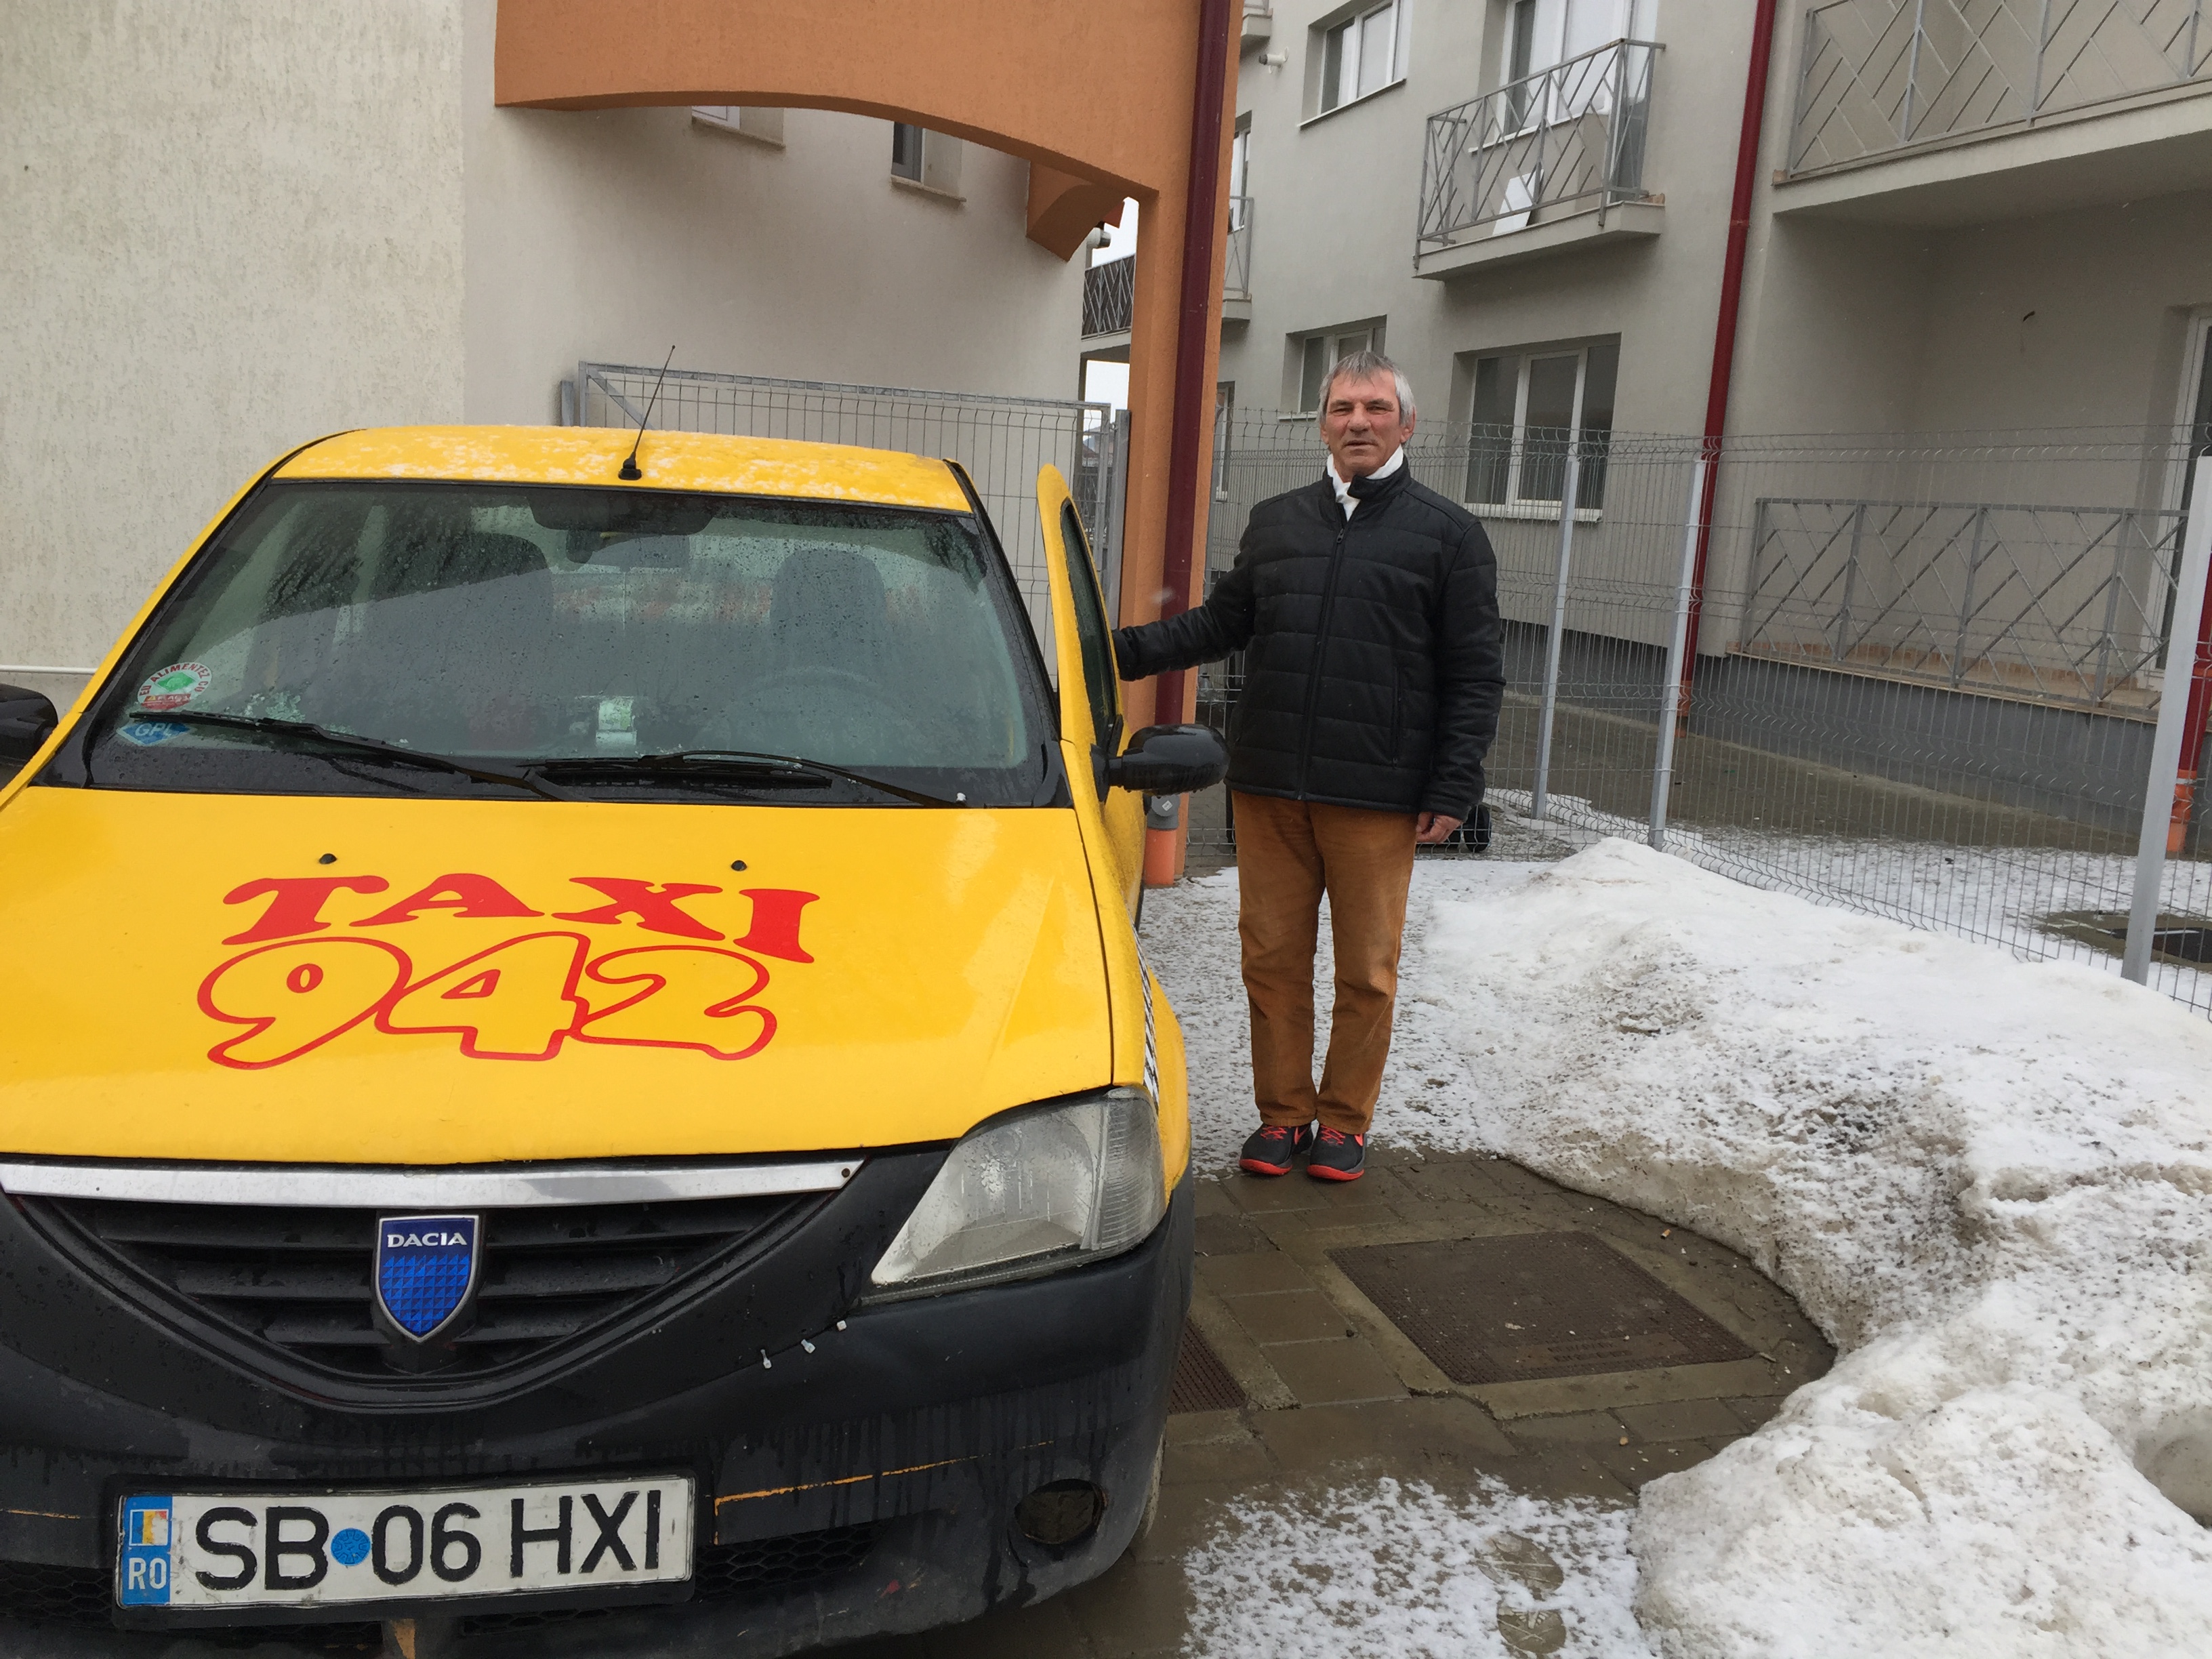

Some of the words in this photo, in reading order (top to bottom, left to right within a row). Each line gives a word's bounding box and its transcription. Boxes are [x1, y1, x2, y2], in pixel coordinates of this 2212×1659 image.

[139, 684, 152, 697] EU
[150, 663, 210, 683] ALIMENTEZ
[135, 722, 173, 737] GPL
[222, 873, 820, 963] TAXI
[197, 931, 777, 1070] 942
[387, 1232, 468, 1248] DACIA
[195, 1506, 329, 1591] SB
[371, 1502, 482, 1586] 06
[510, 1490, 661, 1578] HXI
[127, 1557, 167, 1591] RO
